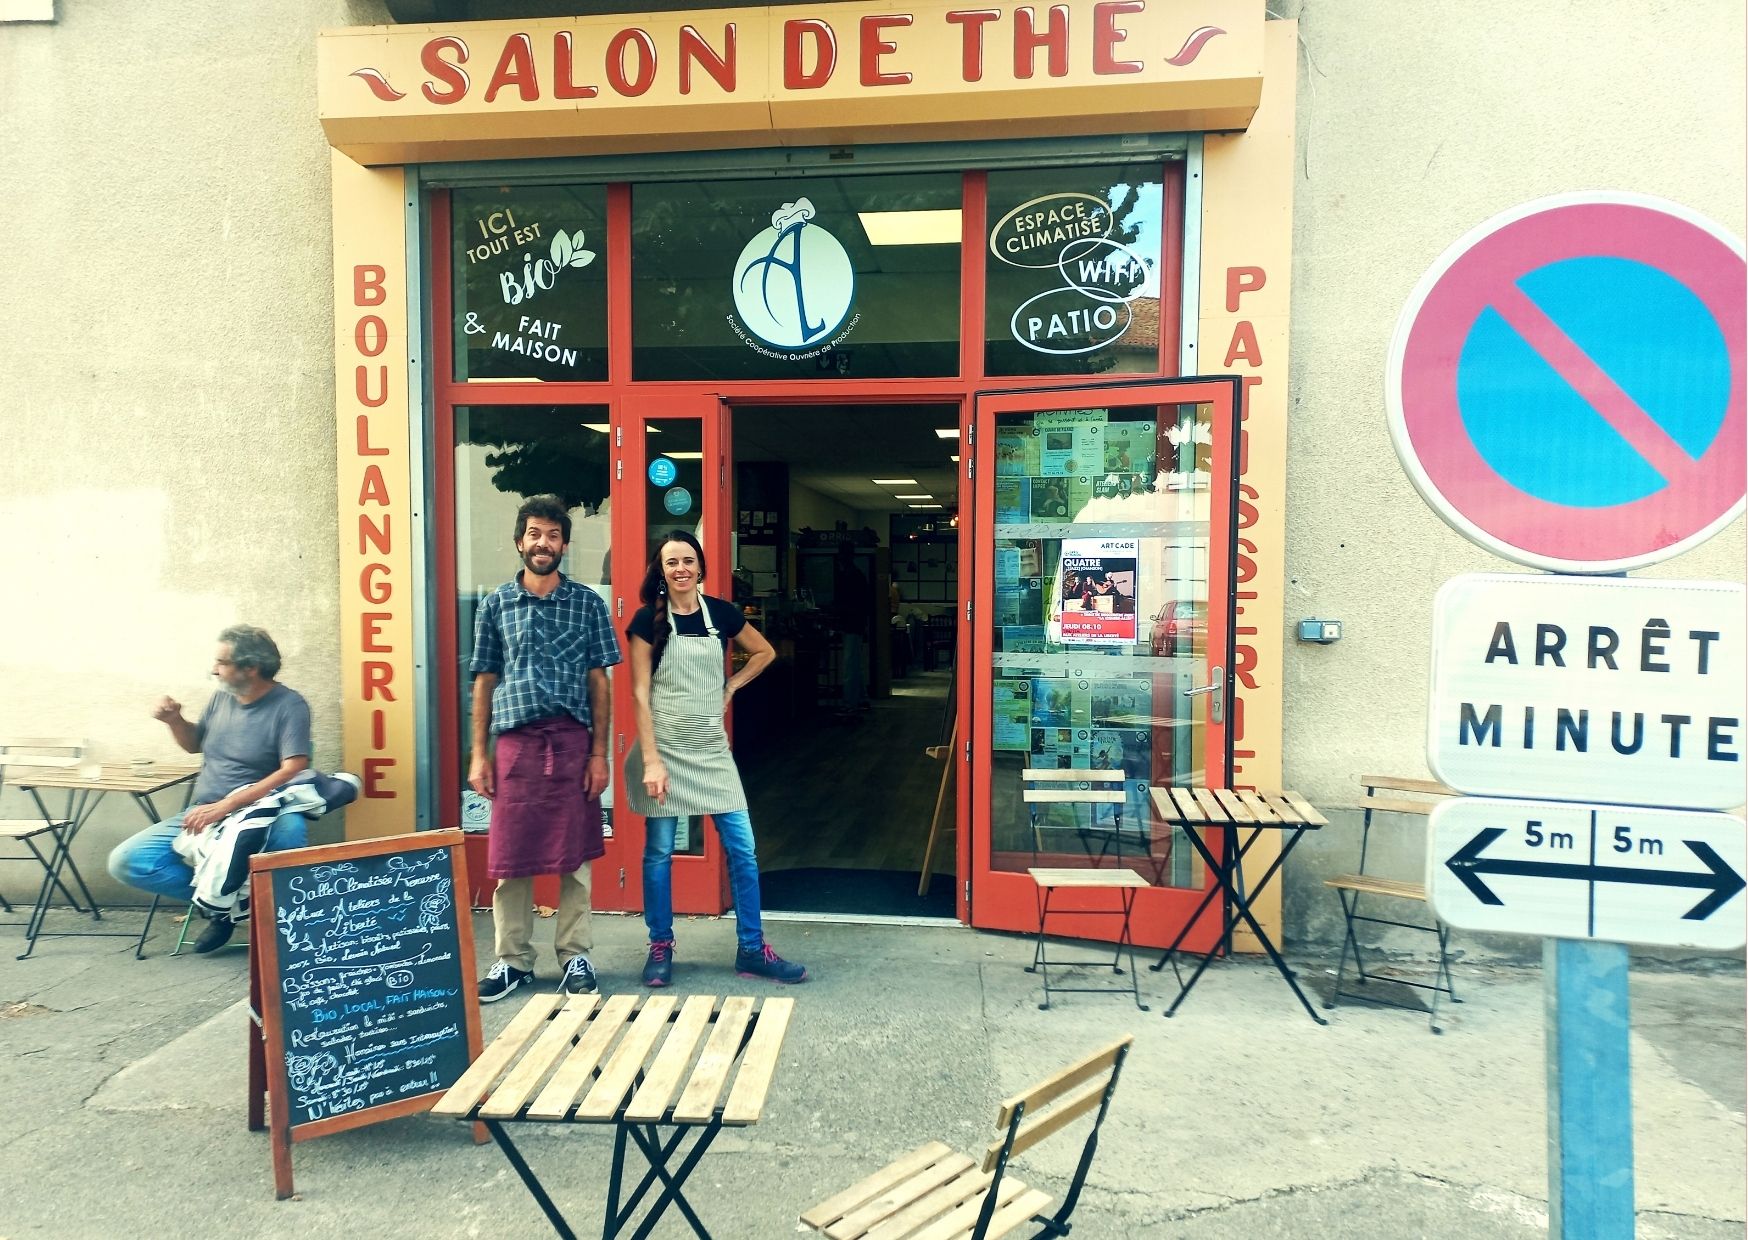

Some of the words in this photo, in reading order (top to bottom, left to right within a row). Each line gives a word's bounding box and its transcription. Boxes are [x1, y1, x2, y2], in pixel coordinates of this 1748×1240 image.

[421, 22, 737, 106] SALON
[783, 14, 914, 90] DE
[946, 0, 1145, 82] THE
[478, 208, 516, 239] ICI
[1015, 202, 1086, 232] ESPACE
[466, 235, 510, 264] TOUT
[513, 222, 541, 246] EST
[1078, 260, 1136, 283] WIFI
[463, 311, 487, 335] &
[518, 315, 562, 341] FAIT
[821, 344, 831, 353] de
[831, 312, 861, 347] Production
[1028, 305, 1117, 341] PATIO
[491, 331, 578, 367] MAISON
[353, 264, 398, 800] BOULANGERIE
[1064, 558, 1101, 567] QUATRE
[1485, 617, 1720, 675] ARRÊT
[1459, 702, 1739, 762] MINUTE
[289, 876, 334, 904] Salle
[331, 897, 380, 923] Ateliers
[388, 896, 400, 904] de
[403, 891, 414, 900] la
[325, 914, 378, 938] Liberté
[344, 1000, 386, 1015] LOCAL,
